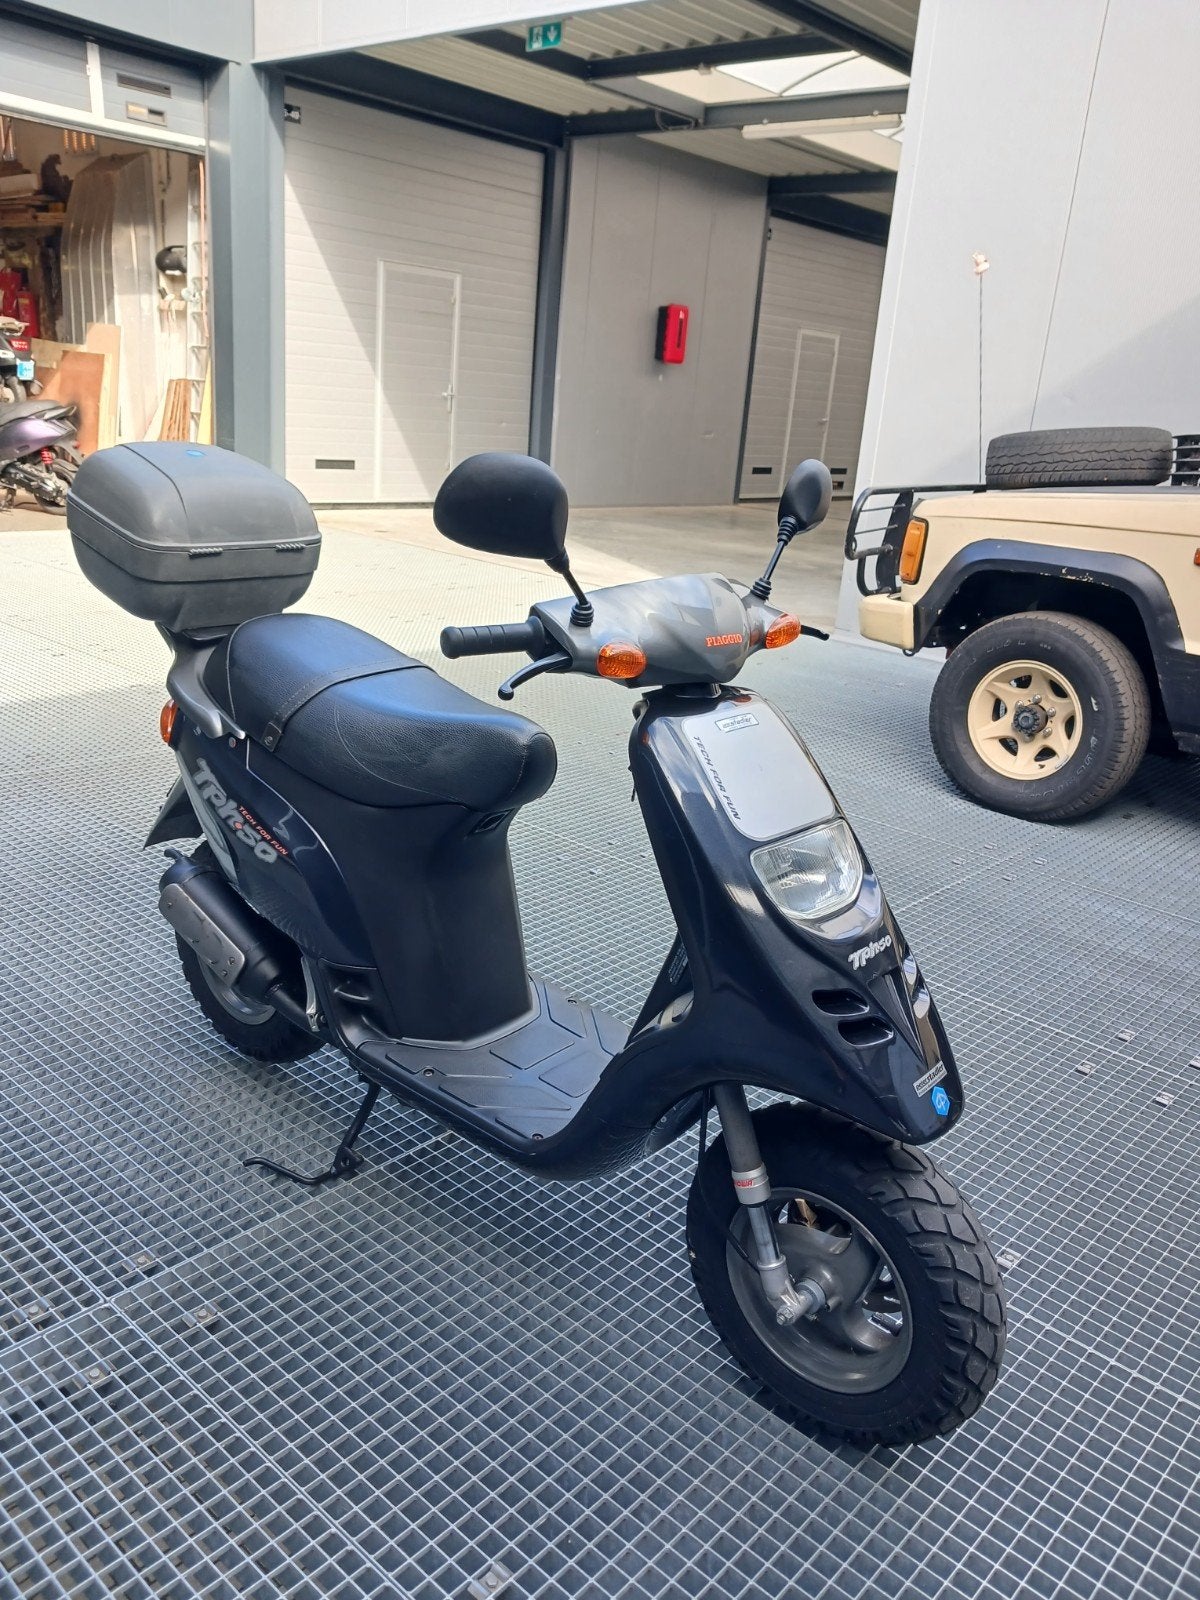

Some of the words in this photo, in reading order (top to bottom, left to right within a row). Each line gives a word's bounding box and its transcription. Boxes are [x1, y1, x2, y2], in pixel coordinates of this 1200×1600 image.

[705, 633, 743, 647] PIAGGIO
[694, 736, 714, 767] TECH
[710, 768, 727, 793] FOR
[723, 795, 742, 820] FUN
[239, 806, 257, 825] TECH
[255, 825, 272, 841] FOR
[270, 840, 289, 856] FUN
